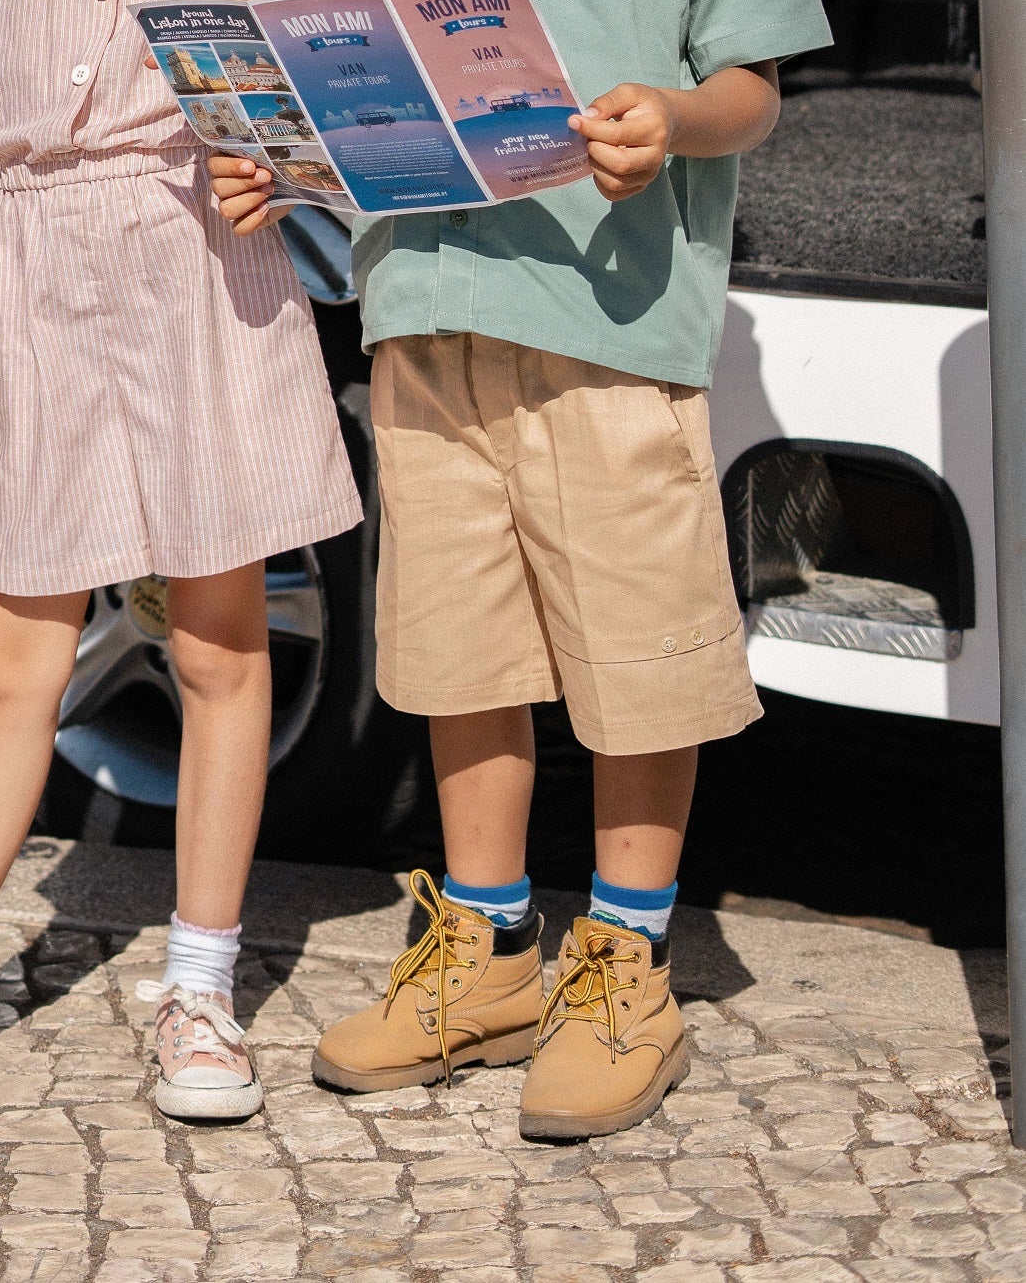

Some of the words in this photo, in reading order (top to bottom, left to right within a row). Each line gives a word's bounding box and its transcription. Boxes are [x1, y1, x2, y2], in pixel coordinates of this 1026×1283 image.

[181, 9, 214, 19] Around
[149, 16, 188, 30] Lisbon
[190, 18, 202, 28] in
[203, 18, 225, 27] one
[227, 15, 250, 30] day
[280, 13, 332, 38] MON
[332, 11, 374, 32] AMI
[458, 18, 487, 29] tours
[322, 37, 350, 46] tours
[471, 45, 504, 61] VAN
[337, 62, 368, 76] VAN
[461, 61, 498, 75] PRIVATE
[498, 58, 526, 69] TOURS
[327, 77, 362, 89] PRIVATE
[362, 74, 391, 85] TOURS
[501, 135, 525, 147] your
[527, 133, 550, 142] new
[493, 142, 527, 156] friend
[528, 143, 539, 152] in
